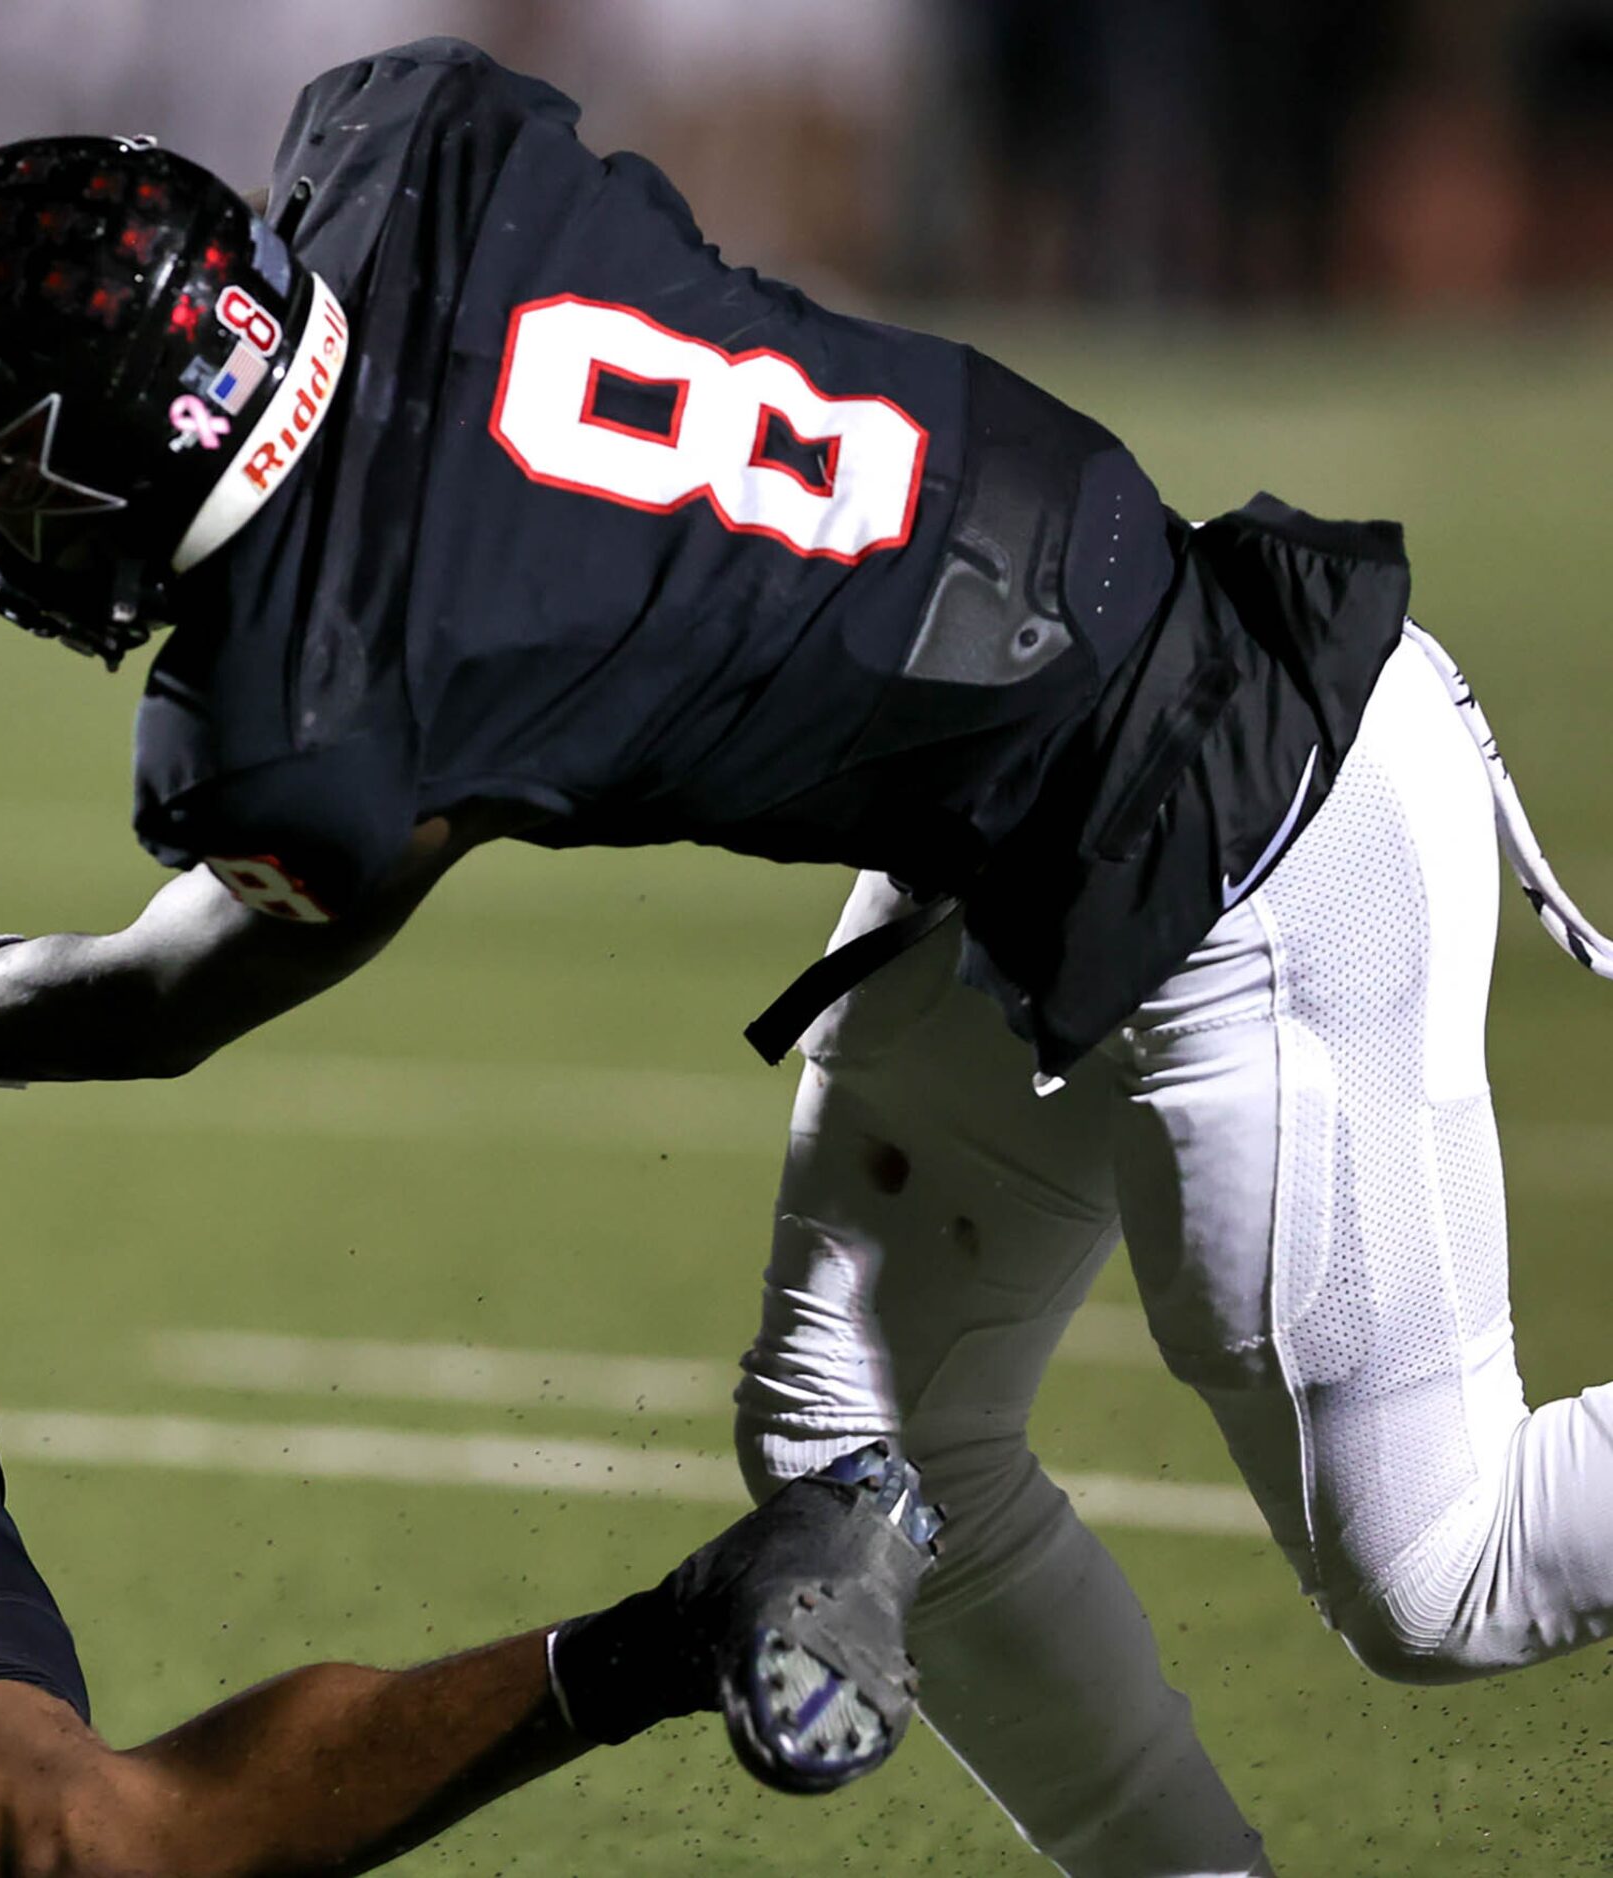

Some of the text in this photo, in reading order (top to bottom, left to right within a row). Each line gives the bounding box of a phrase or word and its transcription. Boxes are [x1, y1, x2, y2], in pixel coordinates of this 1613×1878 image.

[216, 285, 282, 358] 8
[242, 299, 348, 490] Riddell
[489, 292, 929, 567] 8
